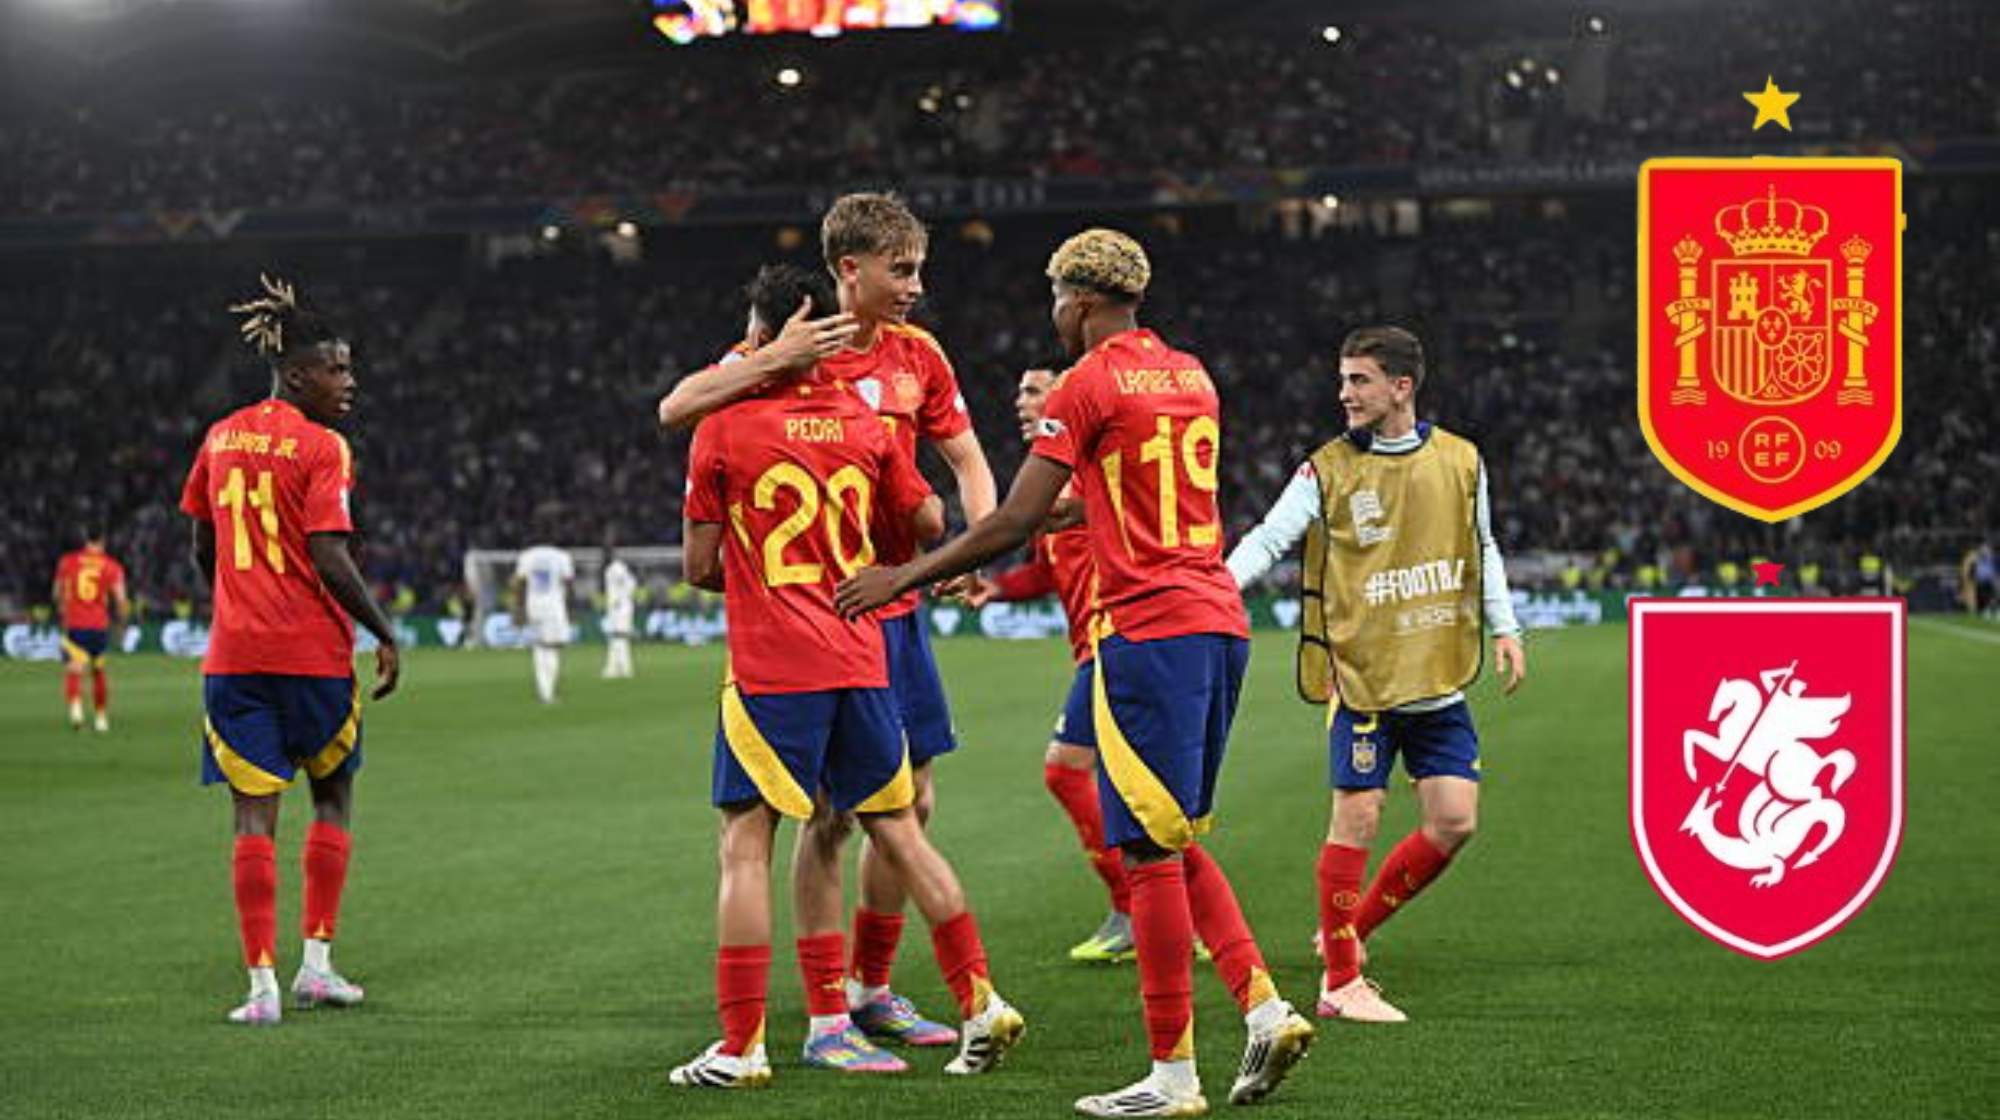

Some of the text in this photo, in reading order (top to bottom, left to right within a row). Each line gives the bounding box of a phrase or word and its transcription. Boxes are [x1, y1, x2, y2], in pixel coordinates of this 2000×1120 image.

[786, 418, 844, 442] PEDRI
[1140, 415, 1220, 547] 19
[218, 468, 285, 574] 11
[754, 461, 875, 587] 20
[78, 568, 99, 601] 6
